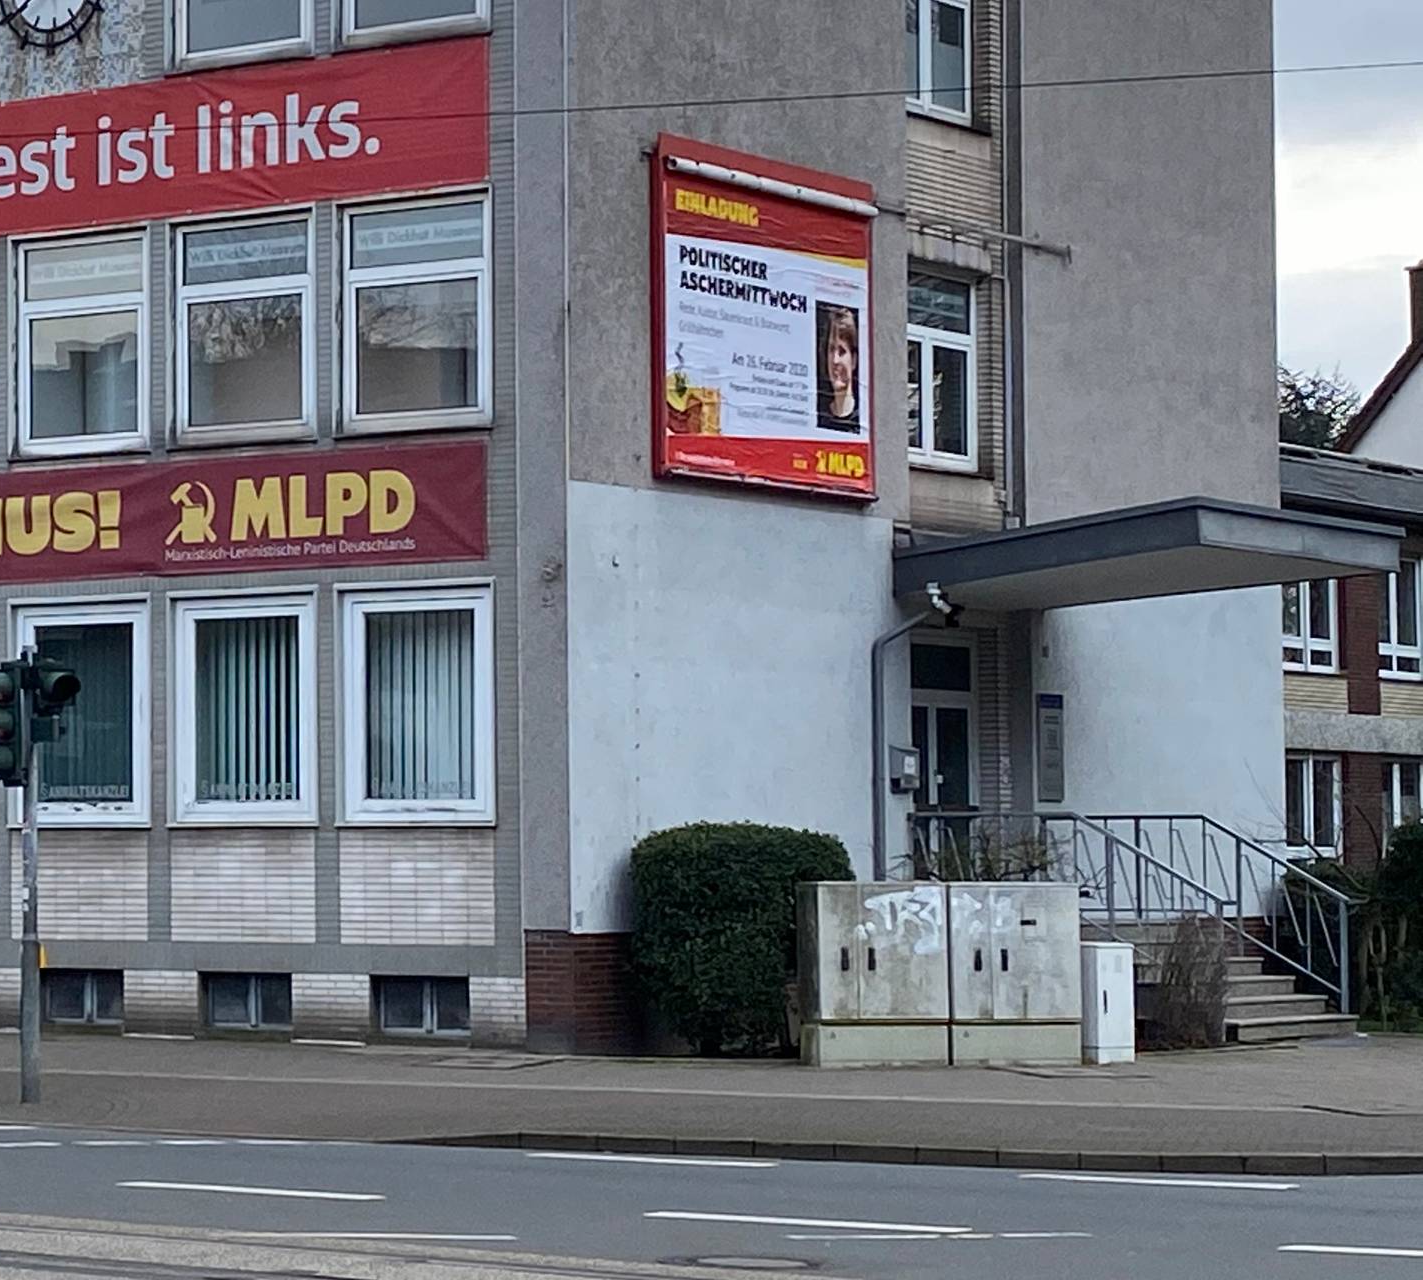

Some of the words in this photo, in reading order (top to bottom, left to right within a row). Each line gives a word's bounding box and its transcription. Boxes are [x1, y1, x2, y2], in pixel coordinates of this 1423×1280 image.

[97, 112, 174, 186] ist
[196, 93, 381, 174] links.
[675, 188, 759, 228] EINLADUNG
[679, 245, 768, 281] POLITISCHER
[230, 468, 417, 541] MLPD
[165, 542, 301, 562] Marxistisch-Leninistische
[304, 540, 337, 556] Partei
[339, 537, 417, 554] Deutschlands
